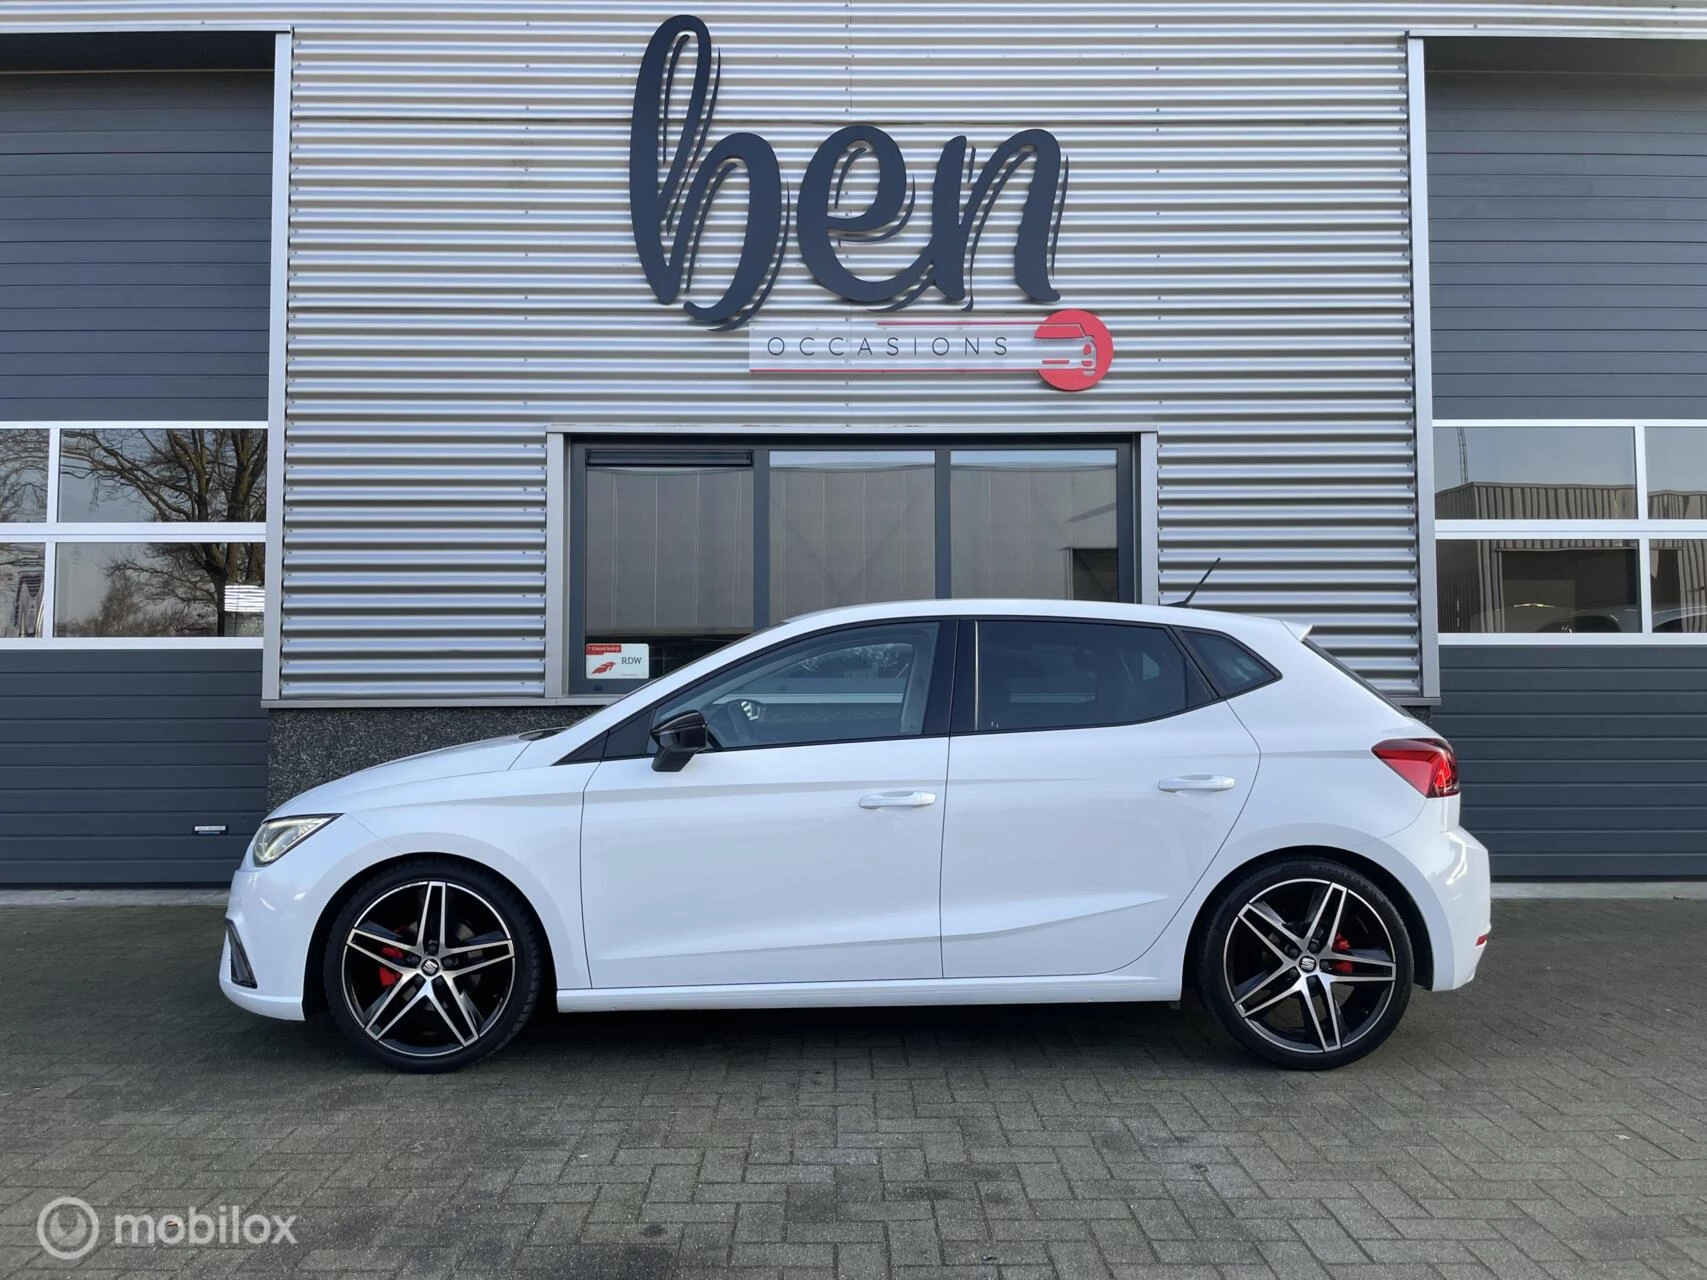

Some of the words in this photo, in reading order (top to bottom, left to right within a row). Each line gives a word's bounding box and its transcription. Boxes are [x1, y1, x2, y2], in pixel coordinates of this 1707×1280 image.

[629, 14, 1069, 331] ben
[767, 337, 1007, 356] OCCASIONS
[621, 656, 642, 665] RDW
